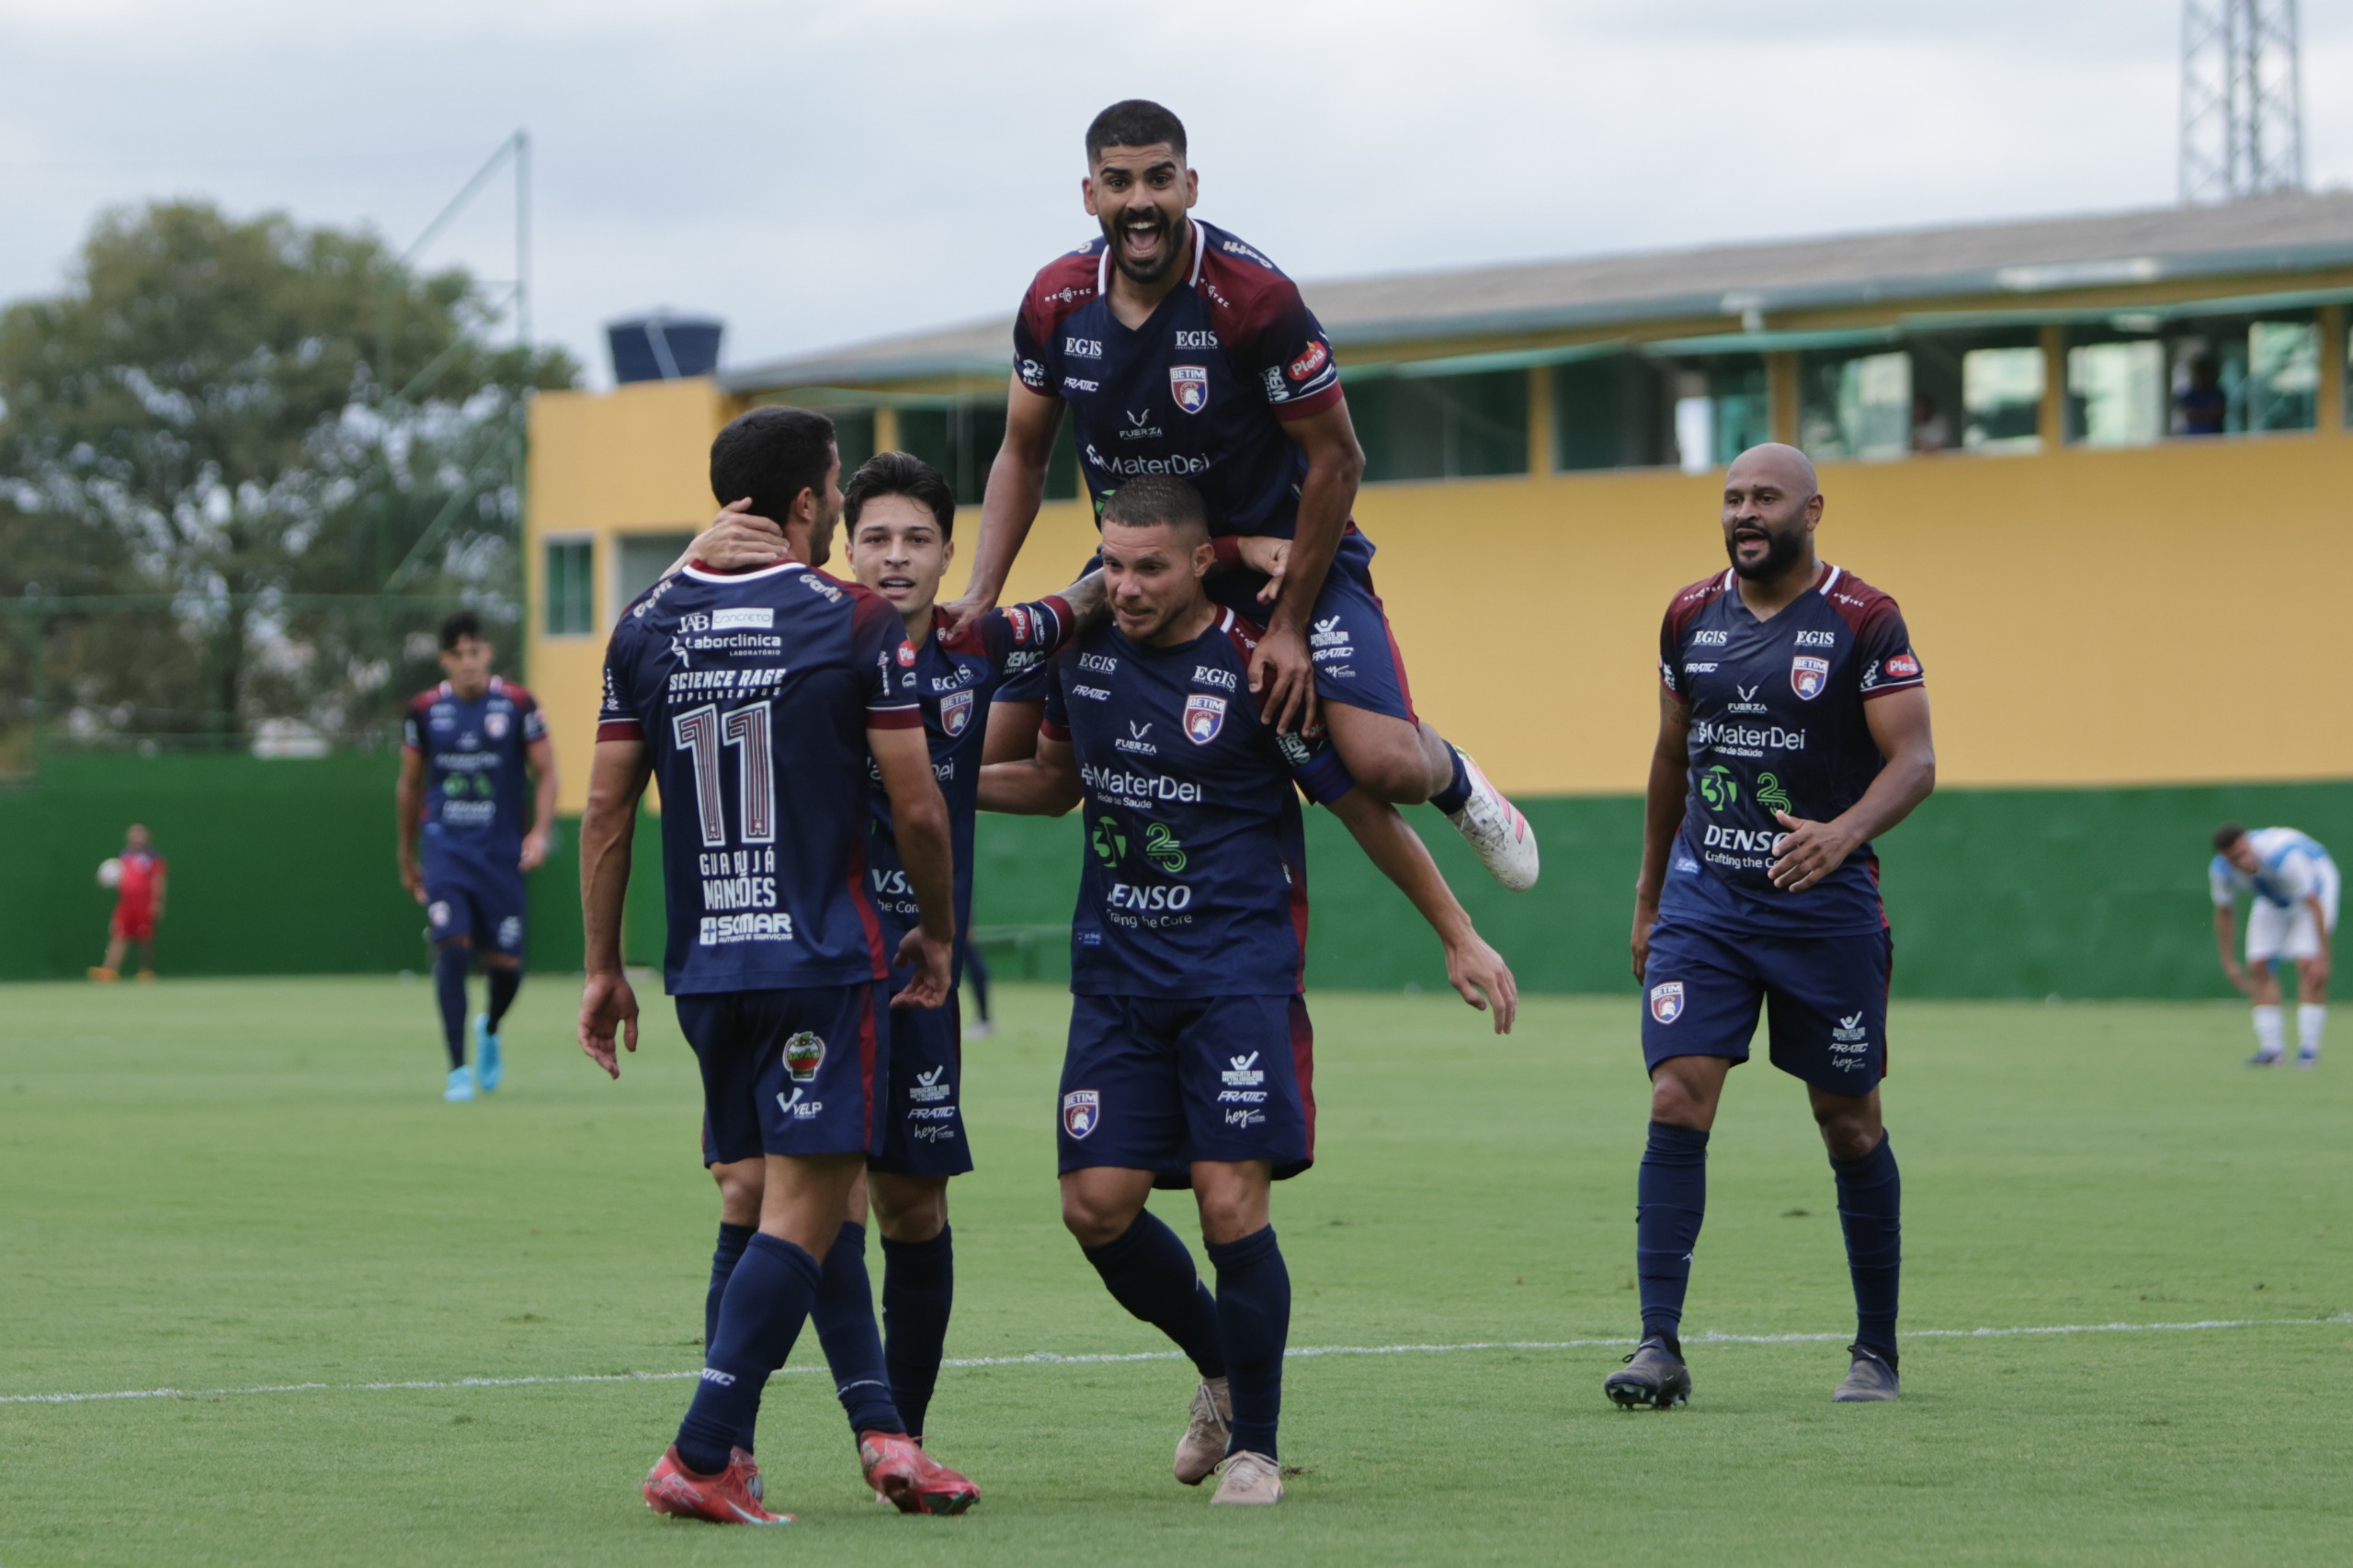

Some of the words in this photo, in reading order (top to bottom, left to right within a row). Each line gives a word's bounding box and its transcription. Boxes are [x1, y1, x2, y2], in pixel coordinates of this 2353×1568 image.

[1065, 336, 1102, 357] EGIS
[1175, 331, 1218, 347] EGIS
[1291, 349, 1324, 376] Plena
[1172, 369, 1206, 381] BETIM
[1063, 376, 1099, 392] PRATIC
[1120, 427, 1162, 438] FUERZA
[1098, 453, 1210, 475] MaterDei
[677, 615, 710, 634] JAB
[1694, 631, 1729, 644] EGIS
[1795, 631, 1836, 645] EGIS
[1312, 646, 1355, 662] PRATIC
[1078, 652, 1119, 673] EGIS
[1685, 663, 1719, 673] PRATIC
[1793, 657, 1827, 672] BETIM
[669, 670, 736, 691] SCIENCE
[738, 668, 787, 687] RAGE
[931, 664, 972, 691] EGIS
[1193, 665, 1238, 689] EGIS
[667, 687, 781, 704] SUPLEMENTOS
[1072, 684, 1110, 700] PRATIC
[942, 692, 972, 710] BETIM
[1188, 698, 1223, 712] BETIM
[1728, 702, 1768, 711] FUERZA
[1707, 722, 1806, 750] MaterDei
[1115, 738, 1157, 754] FUERZA
[672, 701, 775, 847] 11
[1093, 765, 1201, 802] MaterDei
[1123, 796, 1153, 809] Saúde
[1705, 850, 1742, 869] Crafting
[1743, 857, 1763, 869] the
[1828, 1042, 1869, 1053] PRATIC
[1832, 1054, 1862, 1073] hey
[1064, 1093, 1097, 1108] BETIM
[1217, 1090, 1267, 1103] PRATIC
[793, 1102, 823, 1116] VELP
[907, 1106, 956, 1119] PRATIC
[1225, 1108, 1260, 1129] hey
[914, 1123, 949, 1143] hey
